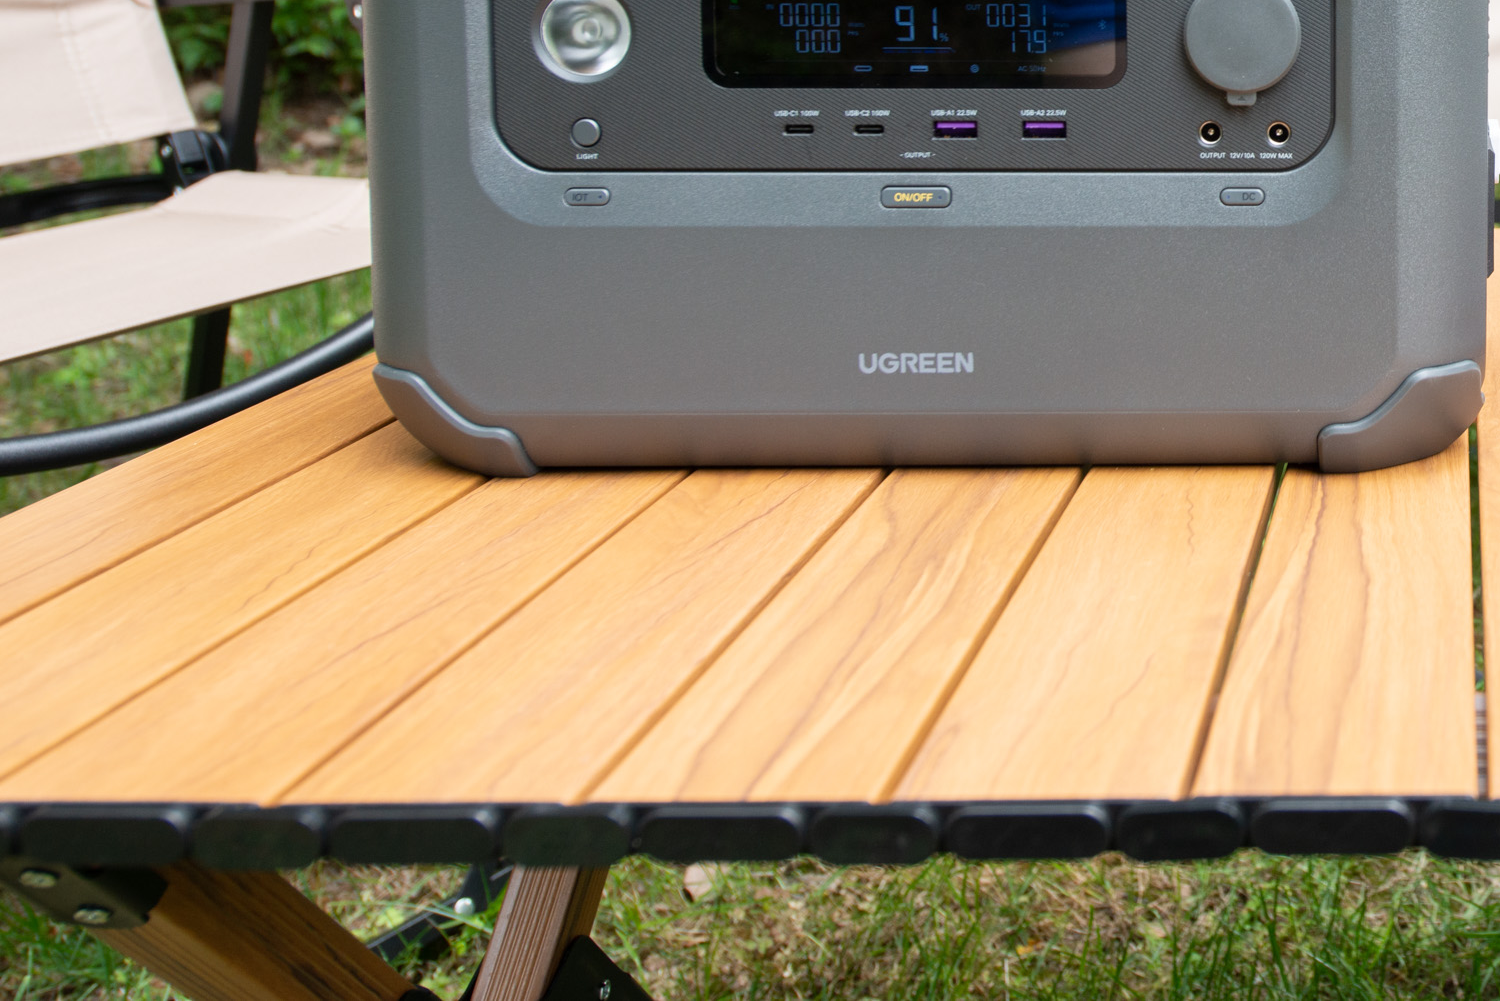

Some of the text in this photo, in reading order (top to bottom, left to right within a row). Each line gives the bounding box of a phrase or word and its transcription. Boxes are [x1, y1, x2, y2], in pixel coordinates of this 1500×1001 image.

[779, 2, 841, 28] 0000
[964, 3, 982, 11] OUT
[986, 3, 1047, 28] 0031
[1017, 65, 1028, 73] AC
[904, 151, 932, 159] OUTPUT
[893, 192, 935, 203] ON/OFF
[1242, 192, 1256, 201] DC
[858, 351, 975, 374] UGREEN
